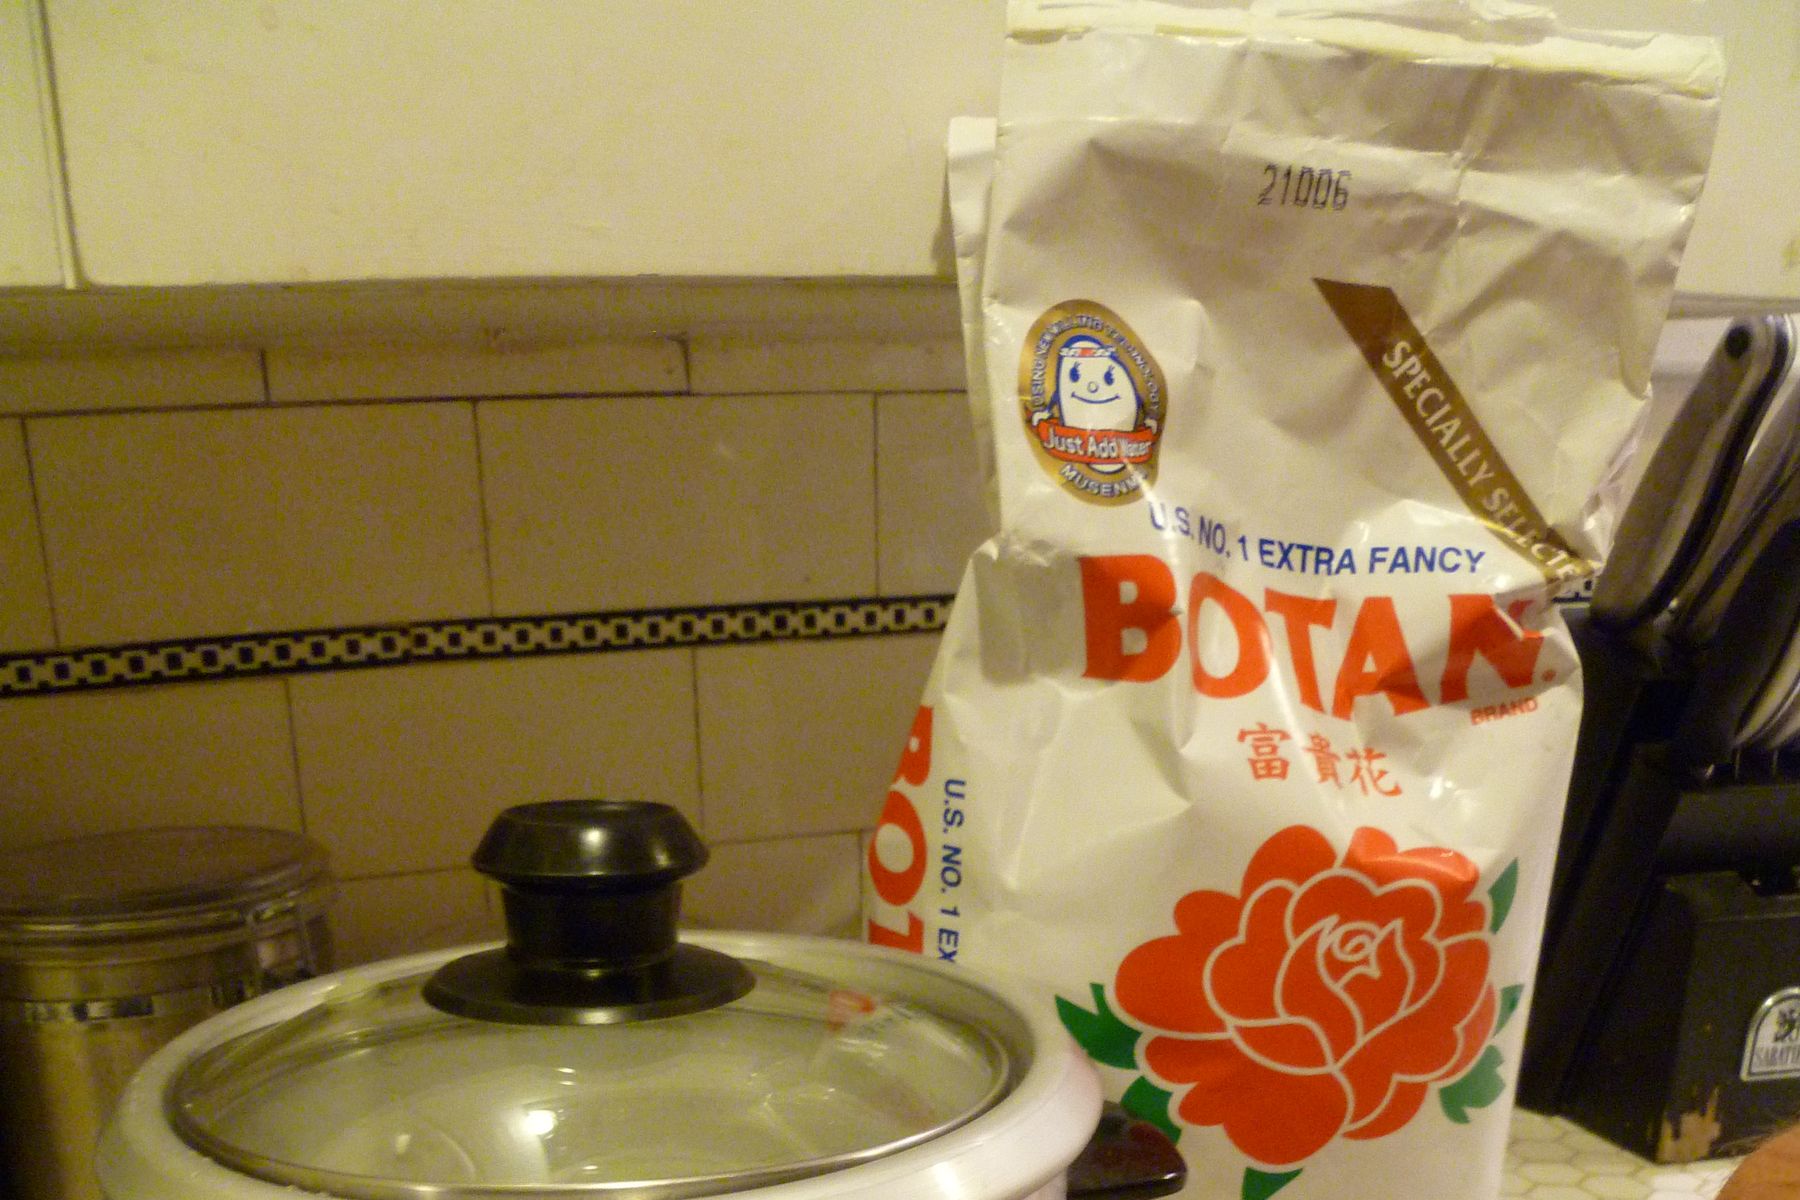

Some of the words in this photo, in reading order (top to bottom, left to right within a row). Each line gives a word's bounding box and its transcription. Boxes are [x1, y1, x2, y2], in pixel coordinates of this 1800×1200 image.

[1257, 163, 1353, 211] 21006
[1382, 340, 1494, 488] SPECIALLY
[1043, 425, 1084, 456] Just
[1087, 435, 1118, 459] Add
[1237, 534, 1249, 562] 1
[1258, 537, 1357, 576] EXTRA
[1368, 546, 1486, 575] FANCY
[1079, 554, 1544, 722] BOTAN
[1470, 697, 1538, 726] BRAND
[1236, 721, 1403, 797] 富貴花
[942, 778, 967, 834] U.S.
[939, 844, 963, 894] NO.
